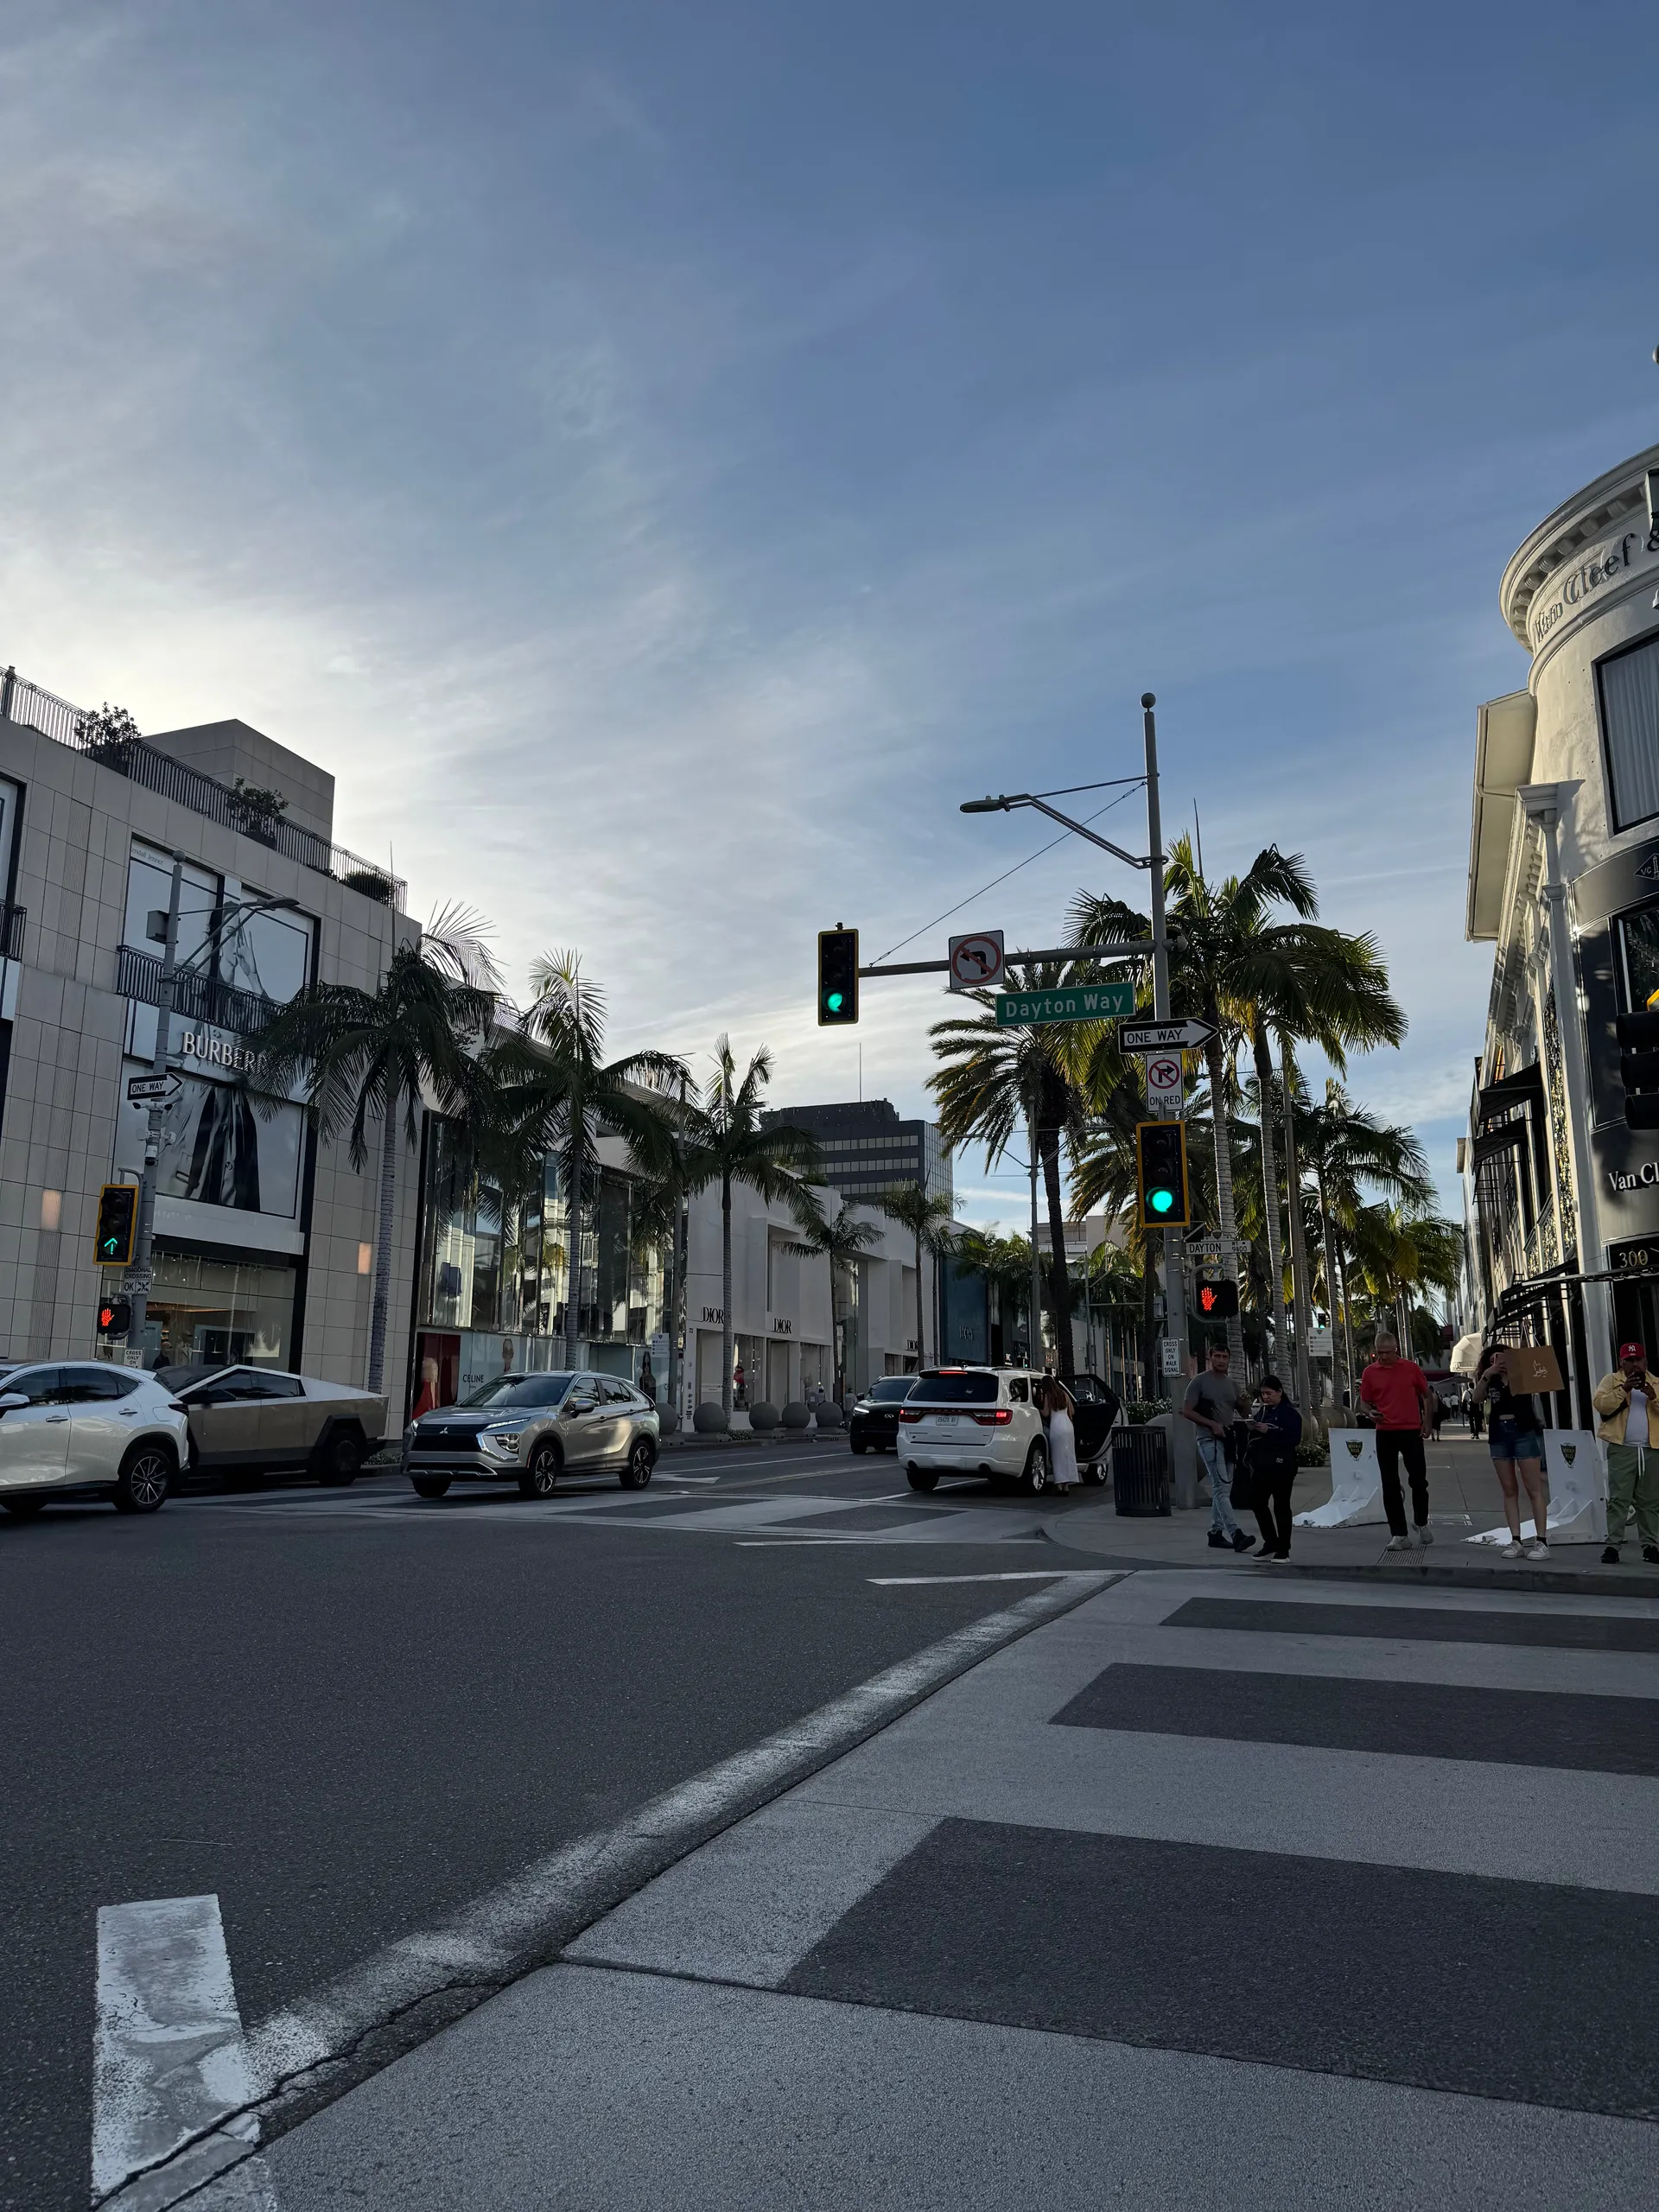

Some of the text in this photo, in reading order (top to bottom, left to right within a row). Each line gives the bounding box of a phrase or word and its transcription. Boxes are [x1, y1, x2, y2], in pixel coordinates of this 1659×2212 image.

[1563, 533, 1635, 605] Cleef
[1006, 994, 1123, 1020] Dayton Way
[1127, 1028, 1183, 1044] ONE WAY
[131, 1081, 164, 1093] ONE WAY
[1149, 1095, 1181, 1106] ON RED
[1608, 1171, 1637, 1191] Van
[1189, 1243, 1222, 1253] DAYTON
[1618, 1249, 1649, 1268] 300
[124, 1281, 135, 1292] OK
[702, 1307, 724, 1324] DIOR
[773, 1319, 791, 1333] DIOR
[462, 1374, 485, 1383] CELINE
